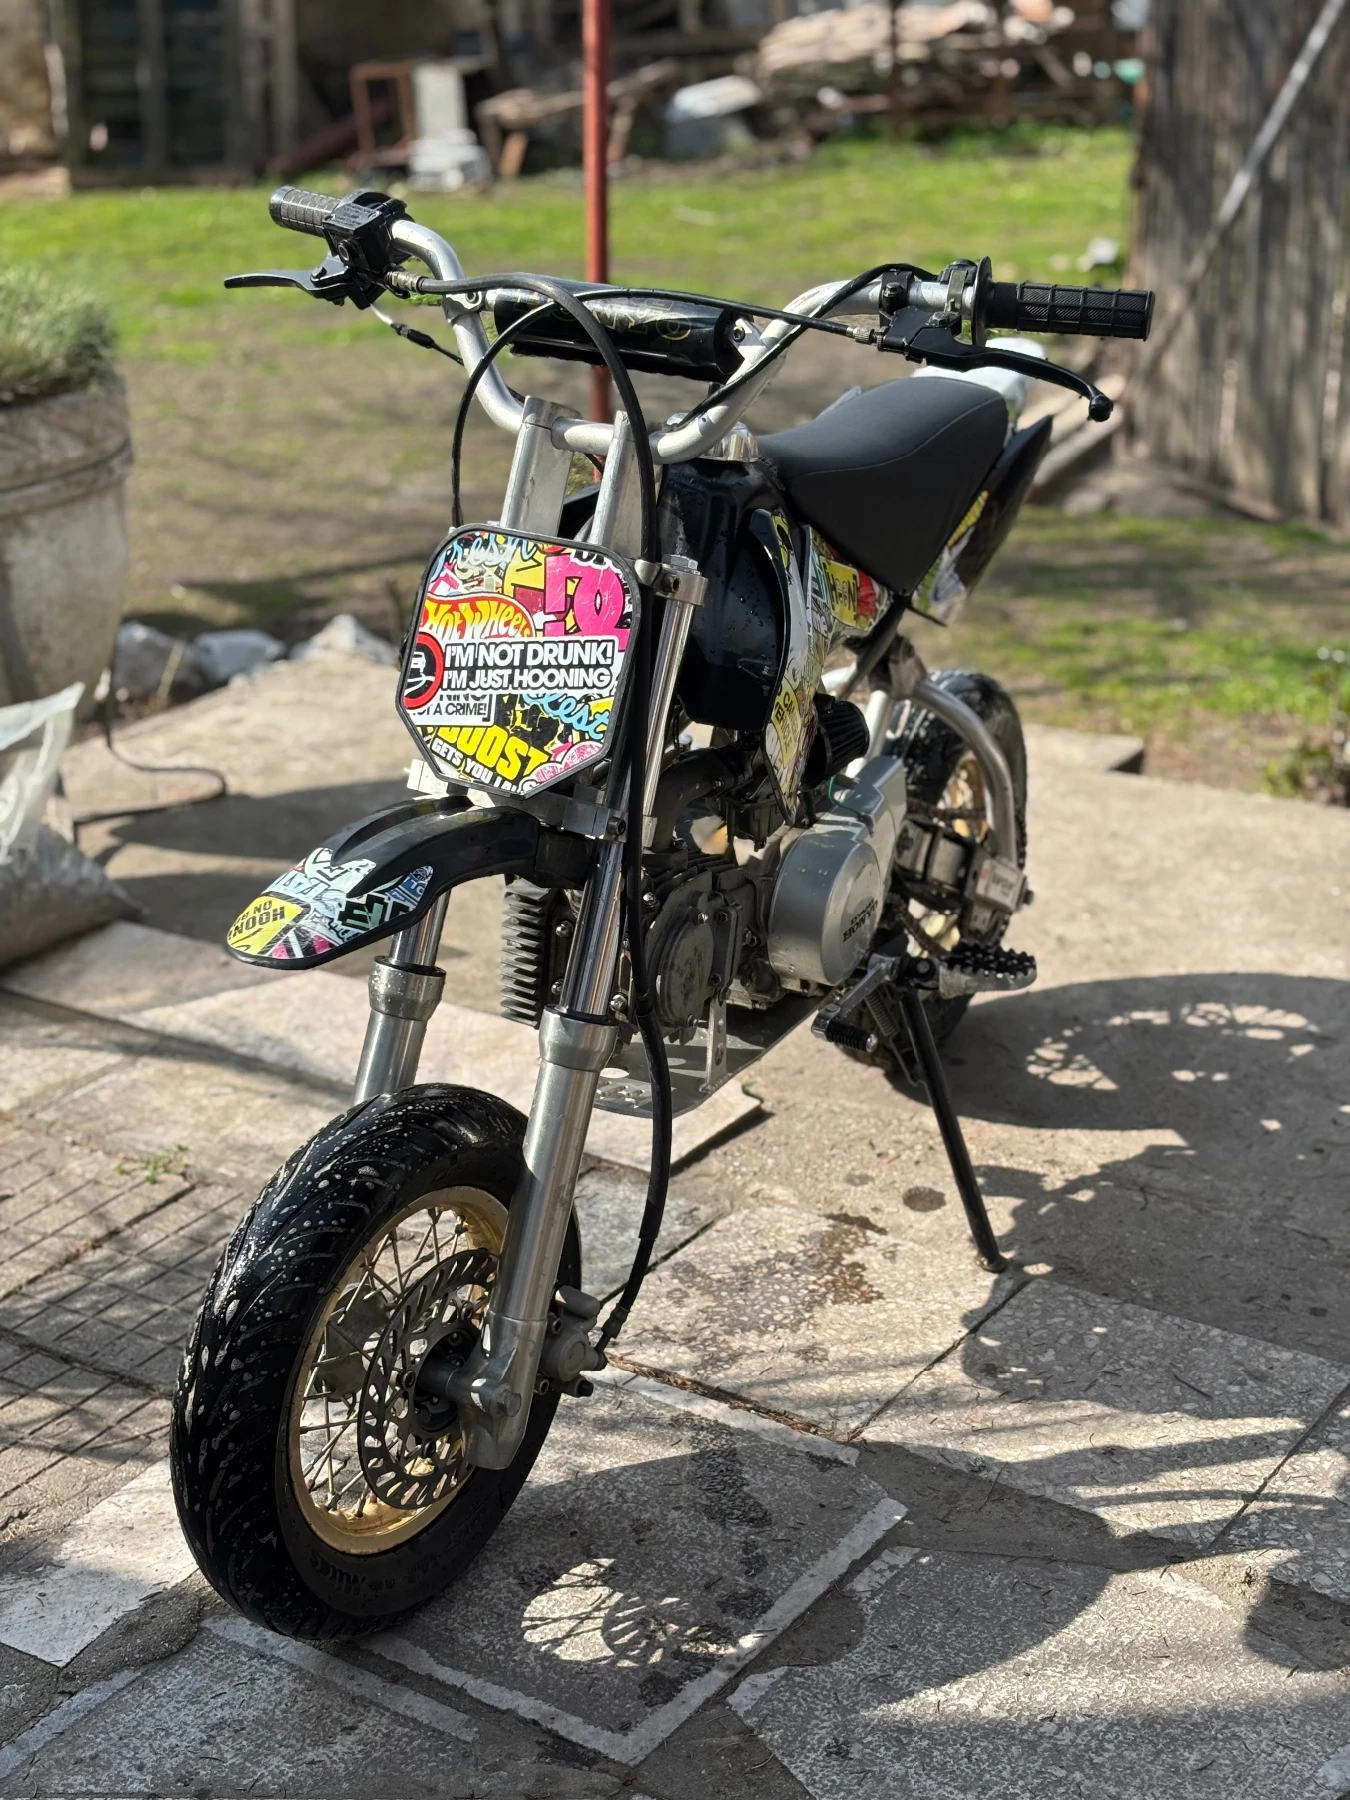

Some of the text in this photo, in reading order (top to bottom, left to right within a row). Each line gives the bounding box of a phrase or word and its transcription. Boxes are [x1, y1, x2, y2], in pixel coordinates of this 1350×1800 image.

[444, 641, 613, 668] I'M NOT DRUNK!
[442, 667, 612, 689] I'M JUST HOONING
[433, 702, 443, 716] A
[445, 702, 488, 716] CRIME!
[431, 738, 464, 767] GETS
[464, 757, 494, 787] YOU
